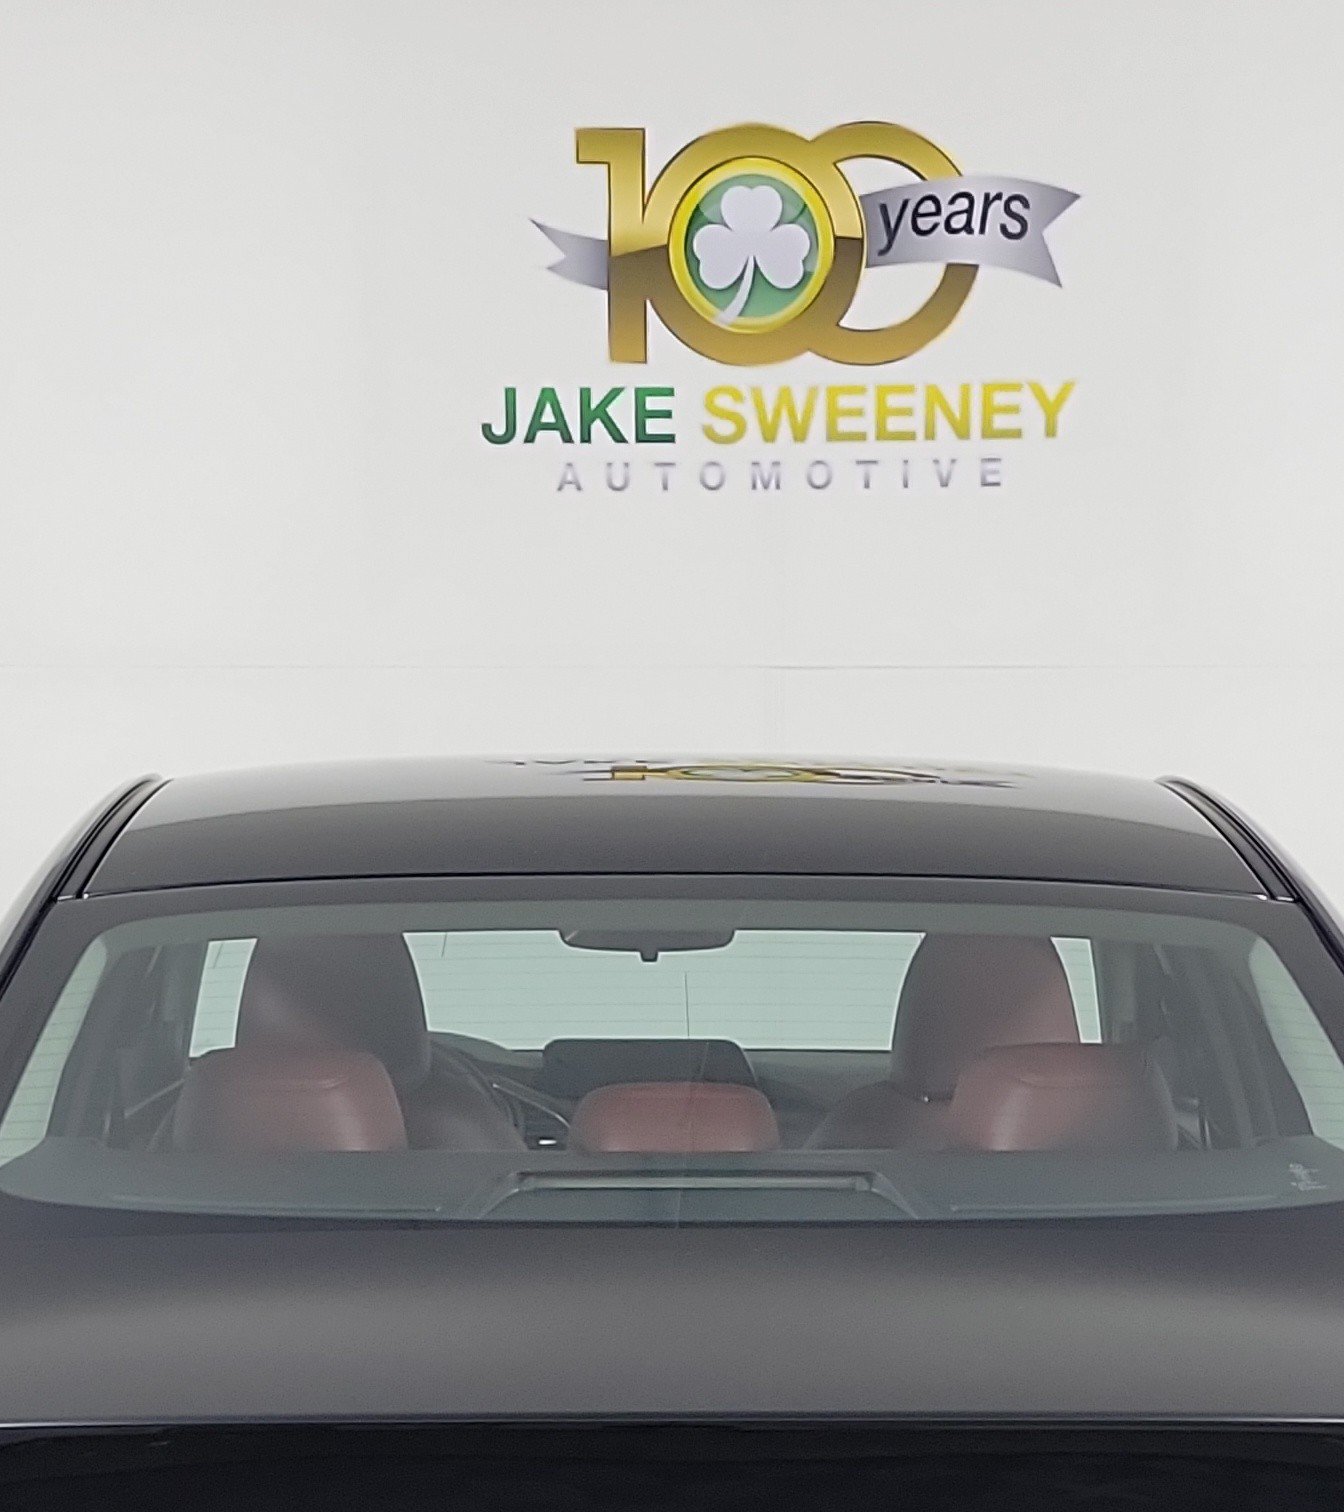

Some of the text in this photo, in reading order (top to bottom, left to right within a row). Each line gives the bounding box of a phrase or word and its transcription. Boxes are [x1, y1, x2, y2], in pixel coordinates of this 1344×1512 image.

[575, 121, 1031, 366] 100 years
[481, 380, 1076, 446] JAKE SWEENEY
[556, 456, 1004, 493] AUTOMOTIVE
